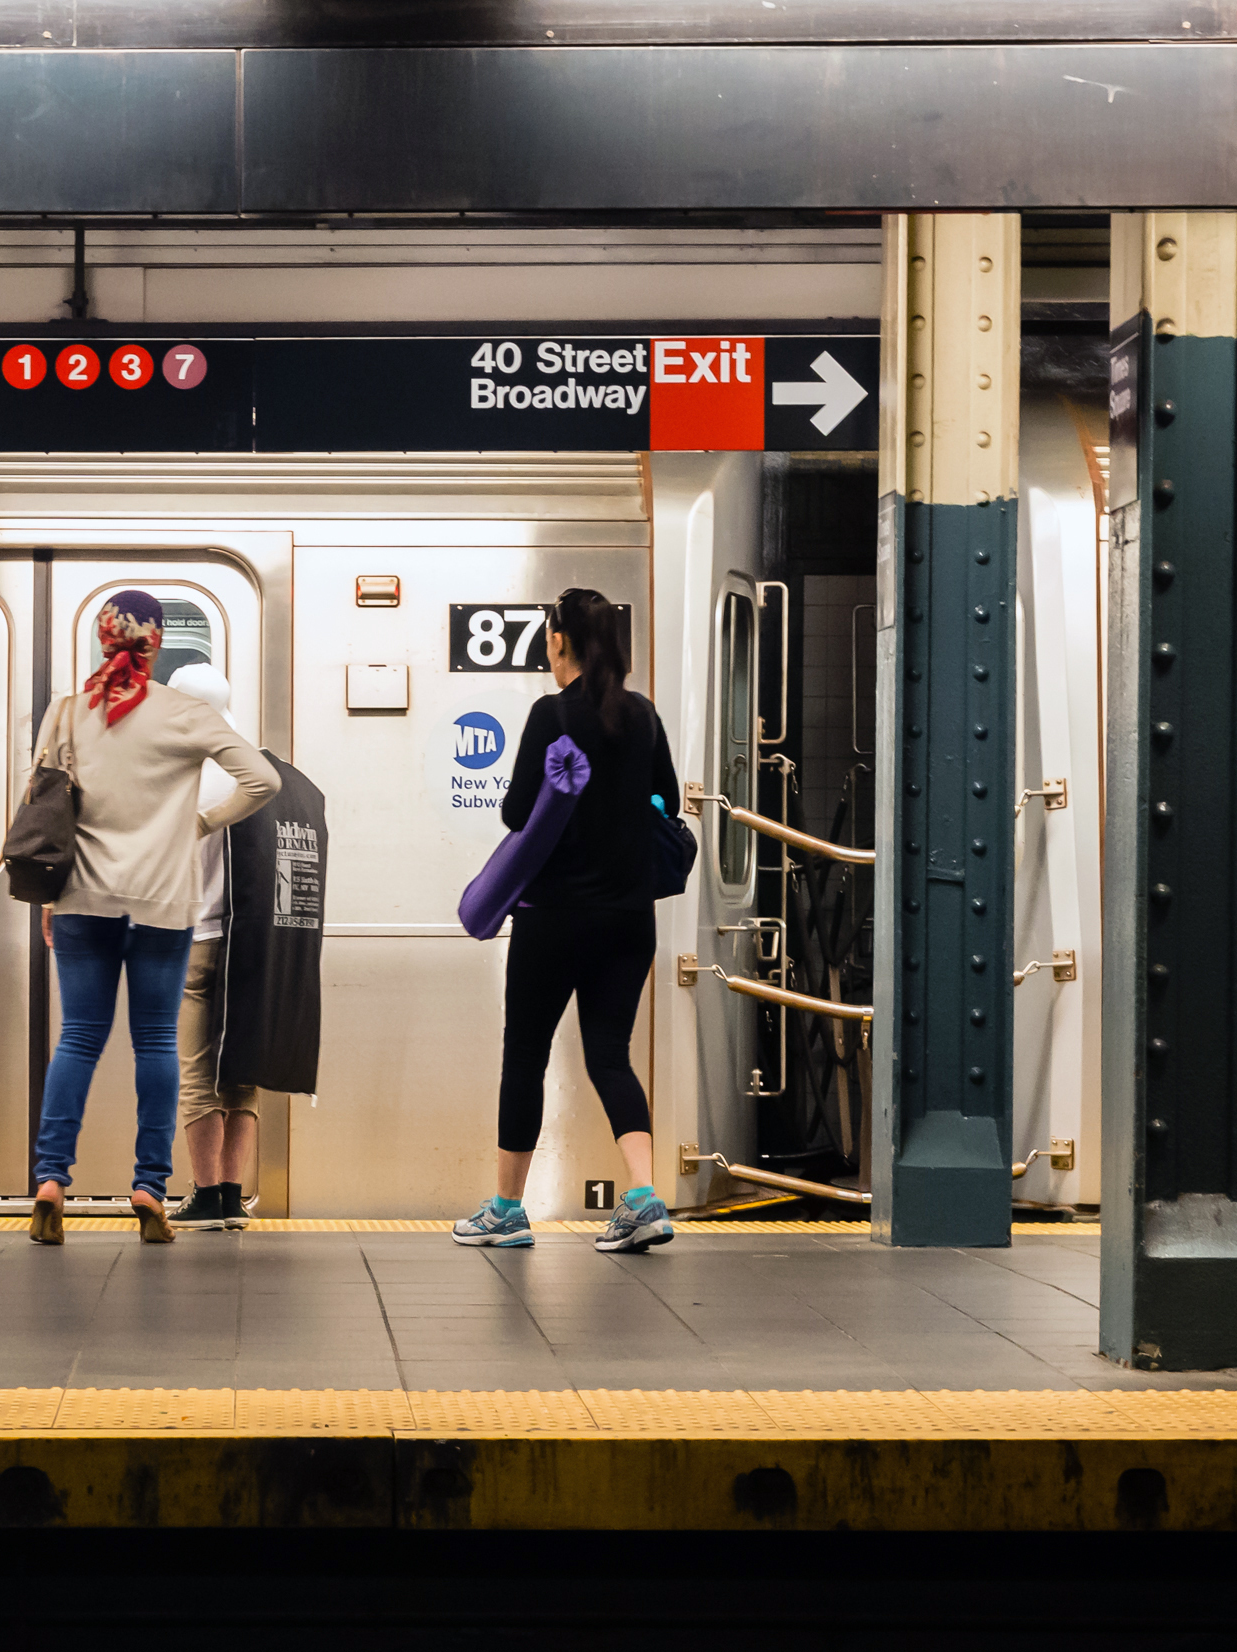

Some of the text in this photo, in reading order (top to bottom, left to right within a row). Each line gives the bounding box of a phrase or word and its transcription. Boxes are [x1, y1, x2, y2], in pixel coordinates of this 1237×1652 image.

[18, 354, 32, 380] 1
[68, 354, 88, 381] 2
[121, 353, 142, 381] 3
[175, 354, 194, 380] 7
[470, 341, 648, 374] 40 Street
[654, 341, 752, 384] Exit
[470, 377, 647, 415] Broadway
[166, 619, 185, 627] hold
[467, 610, 549, 666] 87
[454, 724, 498, 758] MTA
[451, 776, 512, 790] New Yo
[591, 1182, 605, 1208] 1
